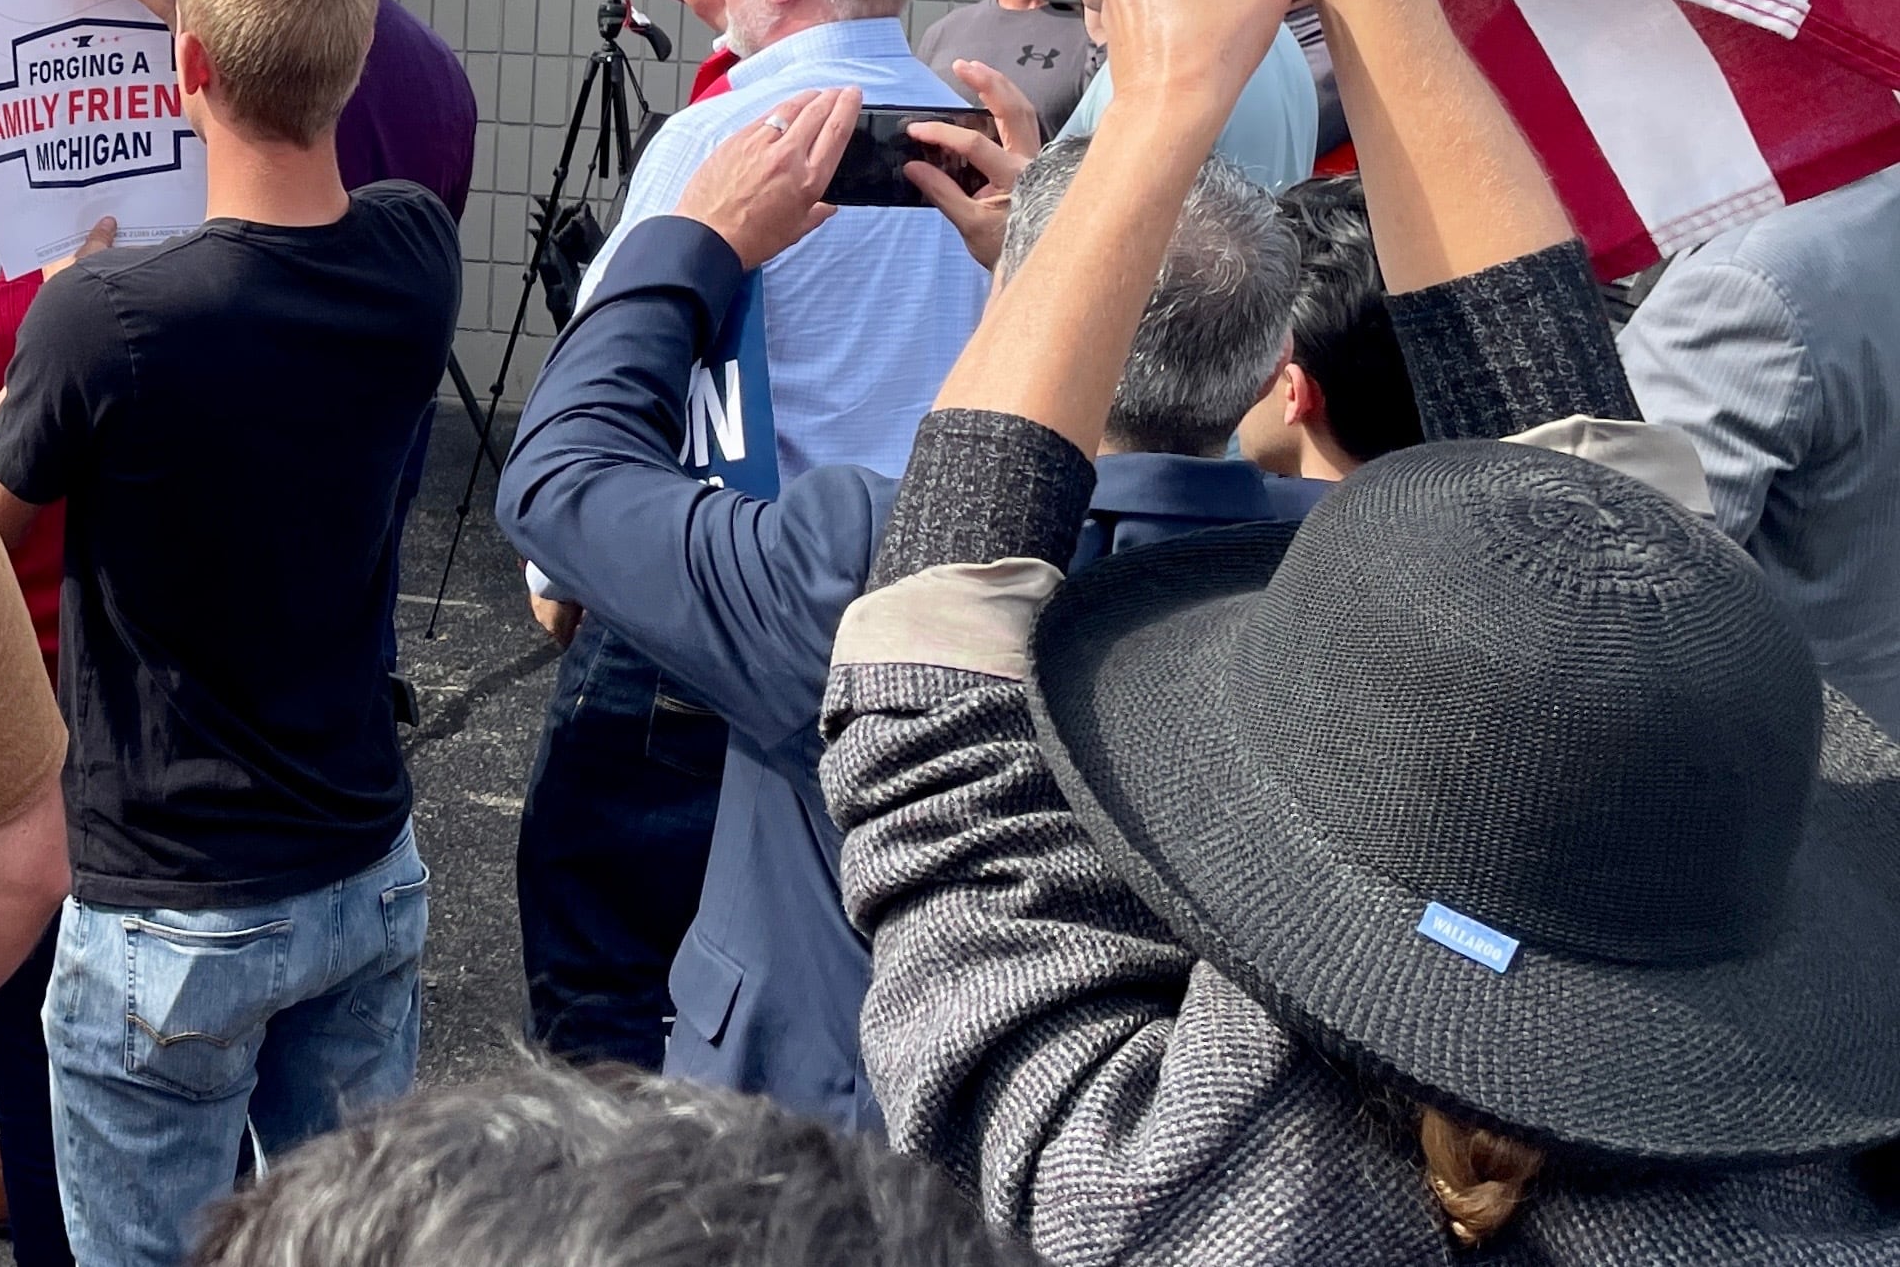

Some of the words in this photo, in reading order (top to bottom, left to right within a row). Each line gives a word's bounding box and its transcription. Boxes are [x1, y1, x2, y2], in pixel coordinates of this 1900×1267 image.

[29, 52, 124, 85] FORGING
[132, 51, 150, 74] A
[36, 131, 152, 171] MICHIGAN
[1432, 915, 1503, 962] WALLAROO
